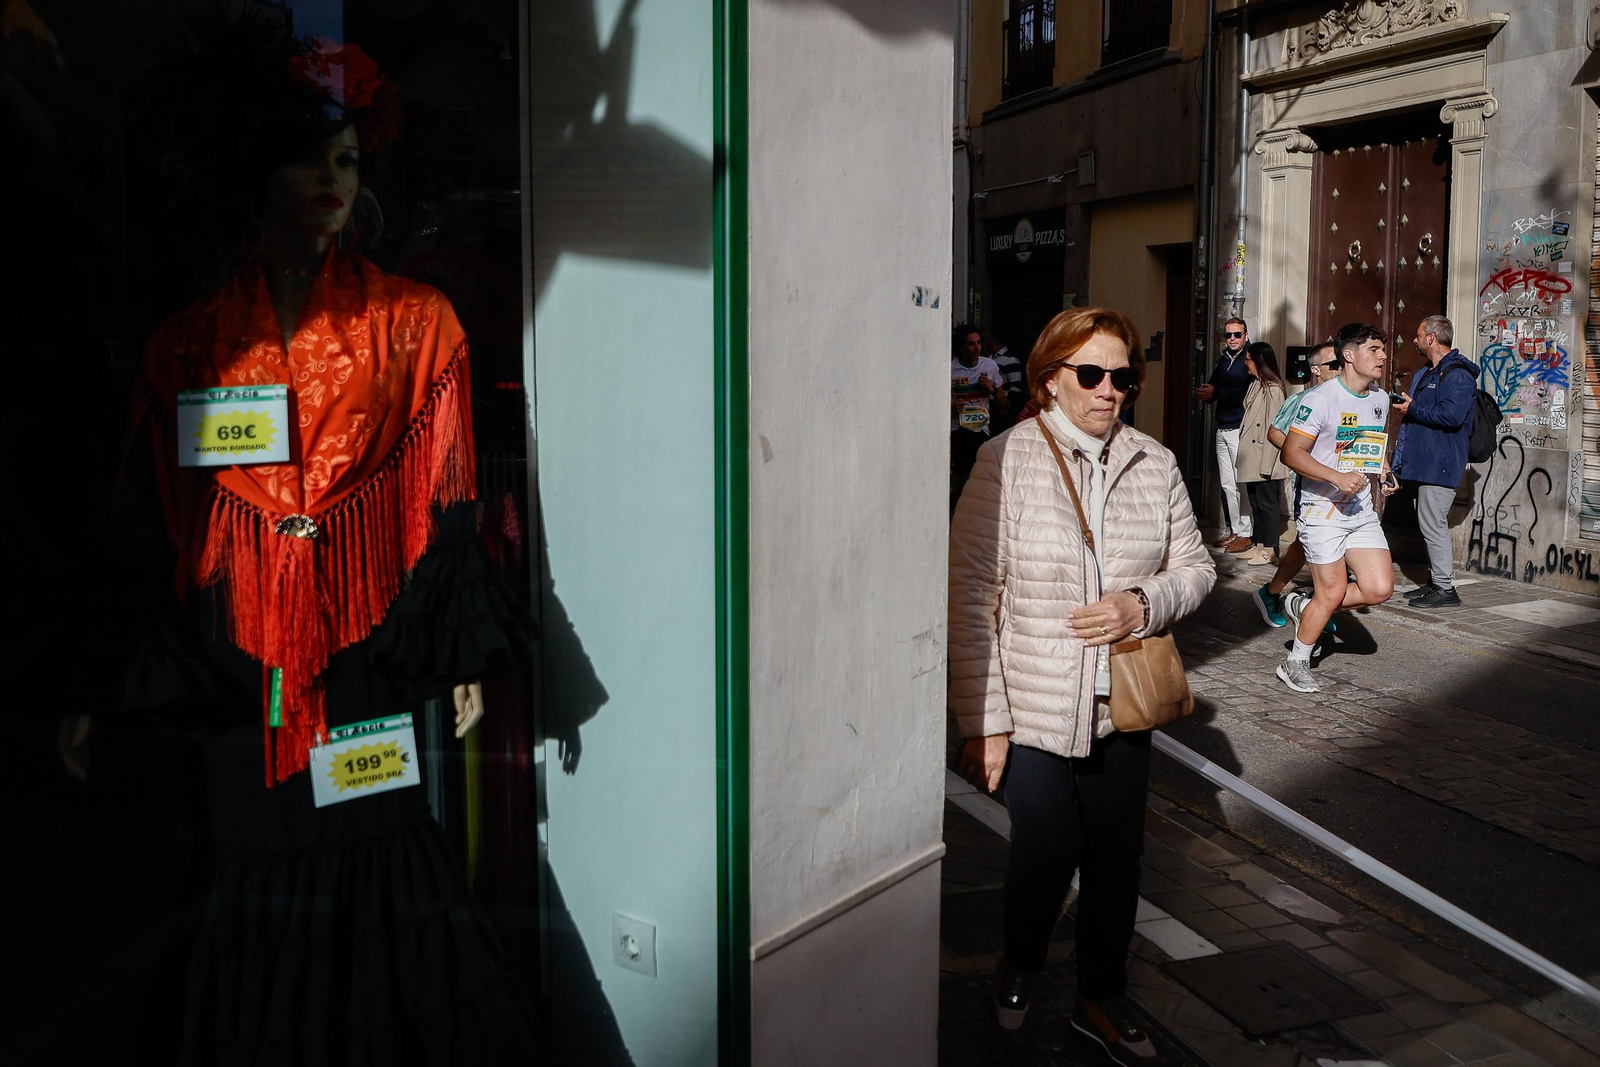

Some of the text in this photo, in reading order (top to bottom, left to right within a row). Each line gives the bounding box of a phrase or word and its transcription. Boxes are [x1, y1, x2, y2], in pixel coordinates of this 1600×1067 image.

[990, 234, 1013, 251] LUXURY
[965, 413, 985, 421] 720
[217, 424, 257, 441] 69€
[229, 443, 267, 452] BORDADO
[346, 772, 384, 787] VESTIDO
